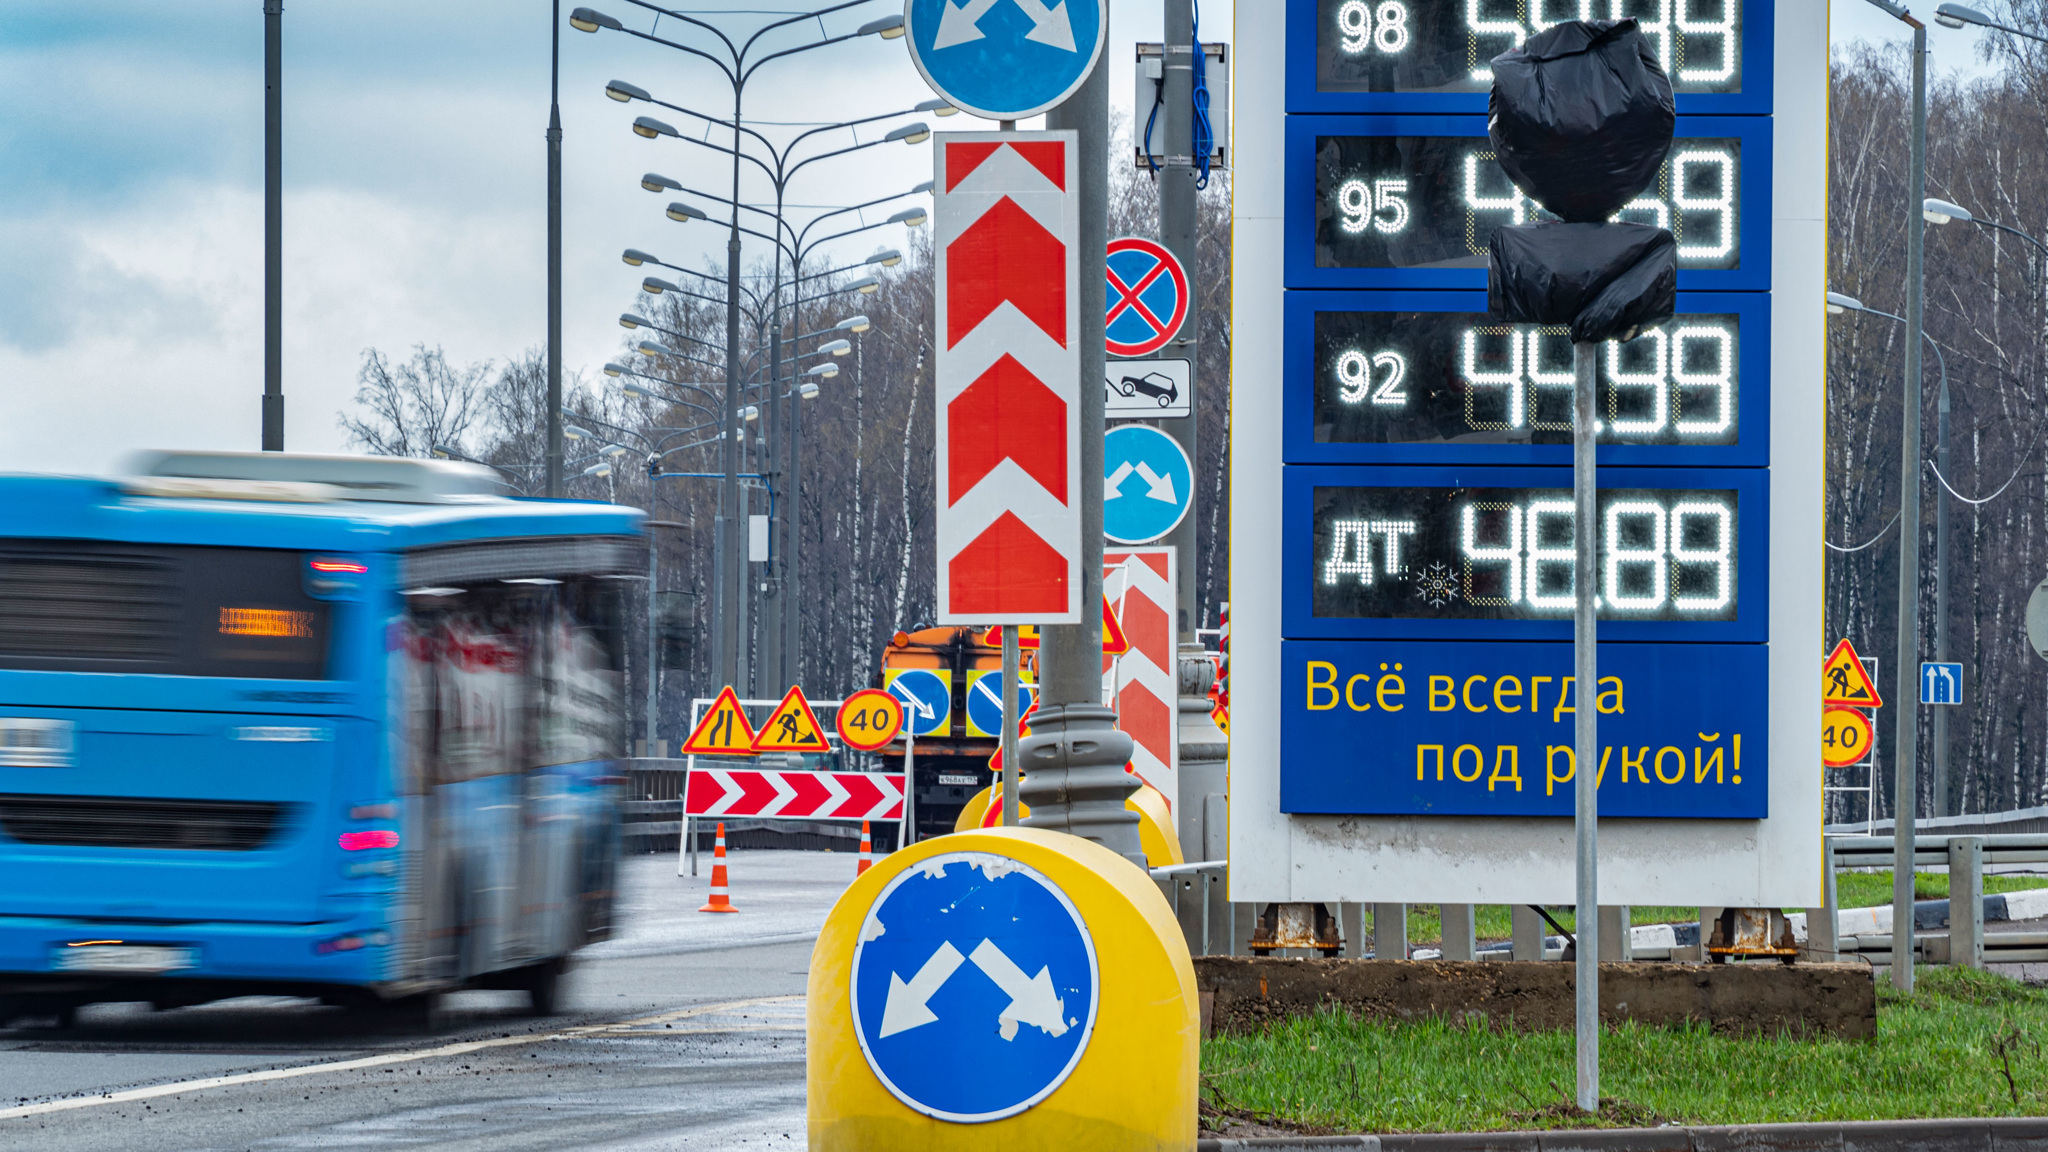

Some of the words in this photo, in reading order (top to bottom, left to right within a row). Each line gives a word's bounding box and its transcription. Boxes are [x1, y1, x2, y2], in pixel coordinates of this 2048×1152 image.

[1337, 0, 1409, 53] 98
[1338, 180, 1410, 234] 95
[1336, 350, 1407, 405] 92
[1325, 520, 1415, 585] ДТ
[1306, 660, 1406, 712] Всё
[849, 708, 889, 731] 40
[1824, 725, 1858, 748] 40
[1416, 744, 1522, 792] под
